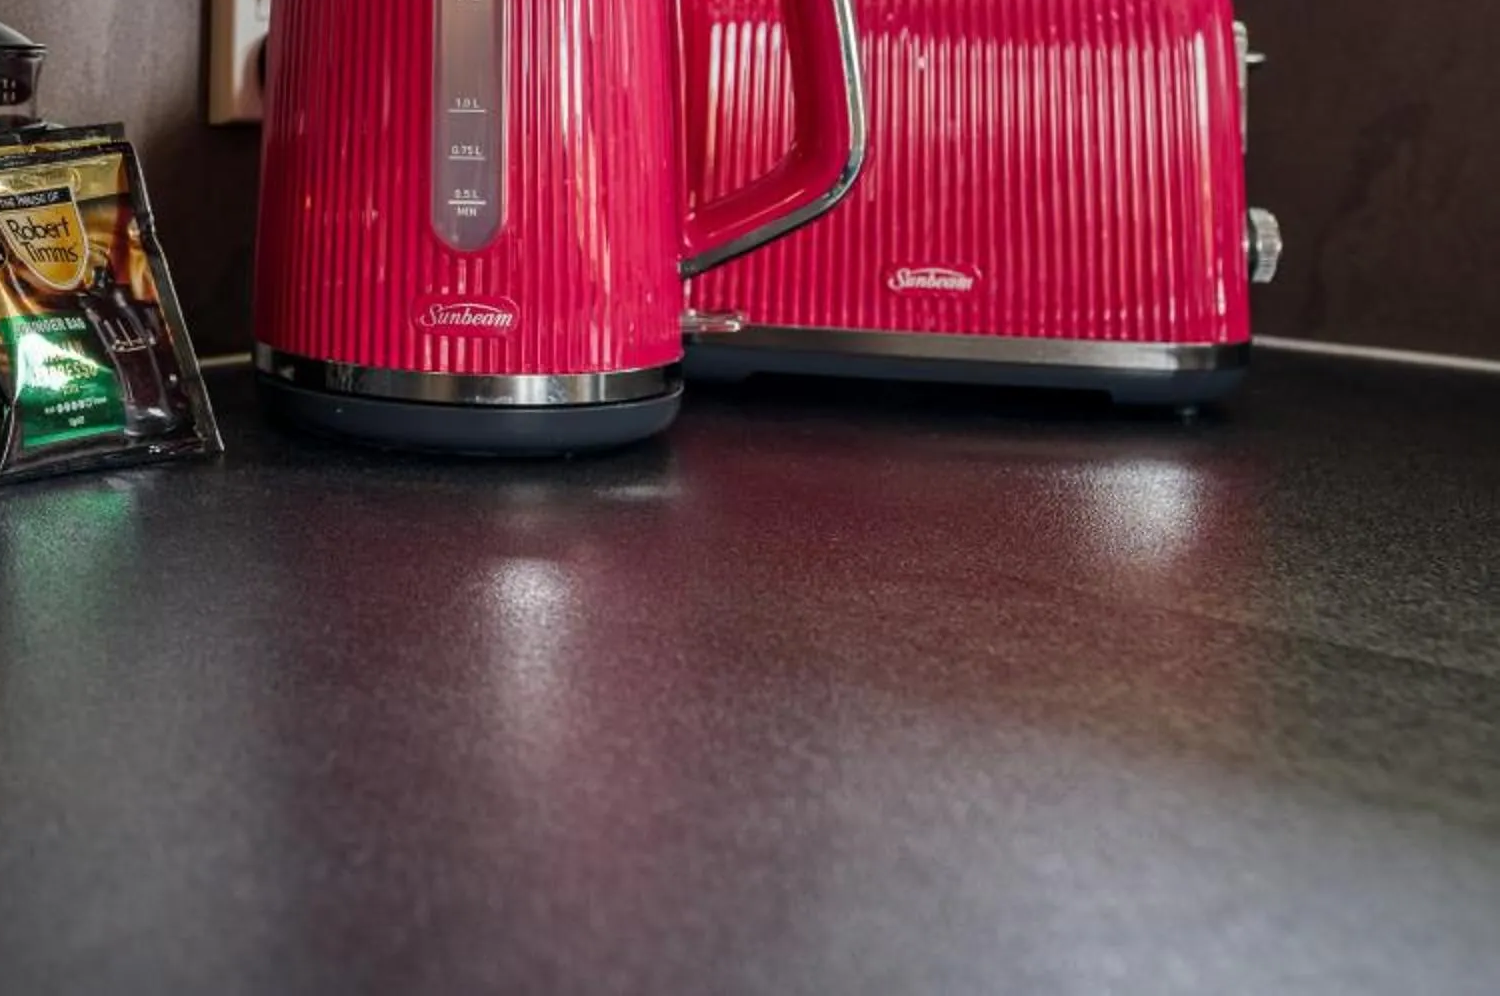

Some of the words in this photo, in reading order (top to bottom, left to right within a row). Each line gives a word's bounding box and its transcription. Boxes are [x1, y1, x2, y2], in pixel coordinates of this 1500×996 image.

[5, 215, 70, 245] Robert
[21, 240, 79, 263] Timms
[887, 267, 974, 293] Sunbeam
[420, 304, 513, 327] Sunbeam
